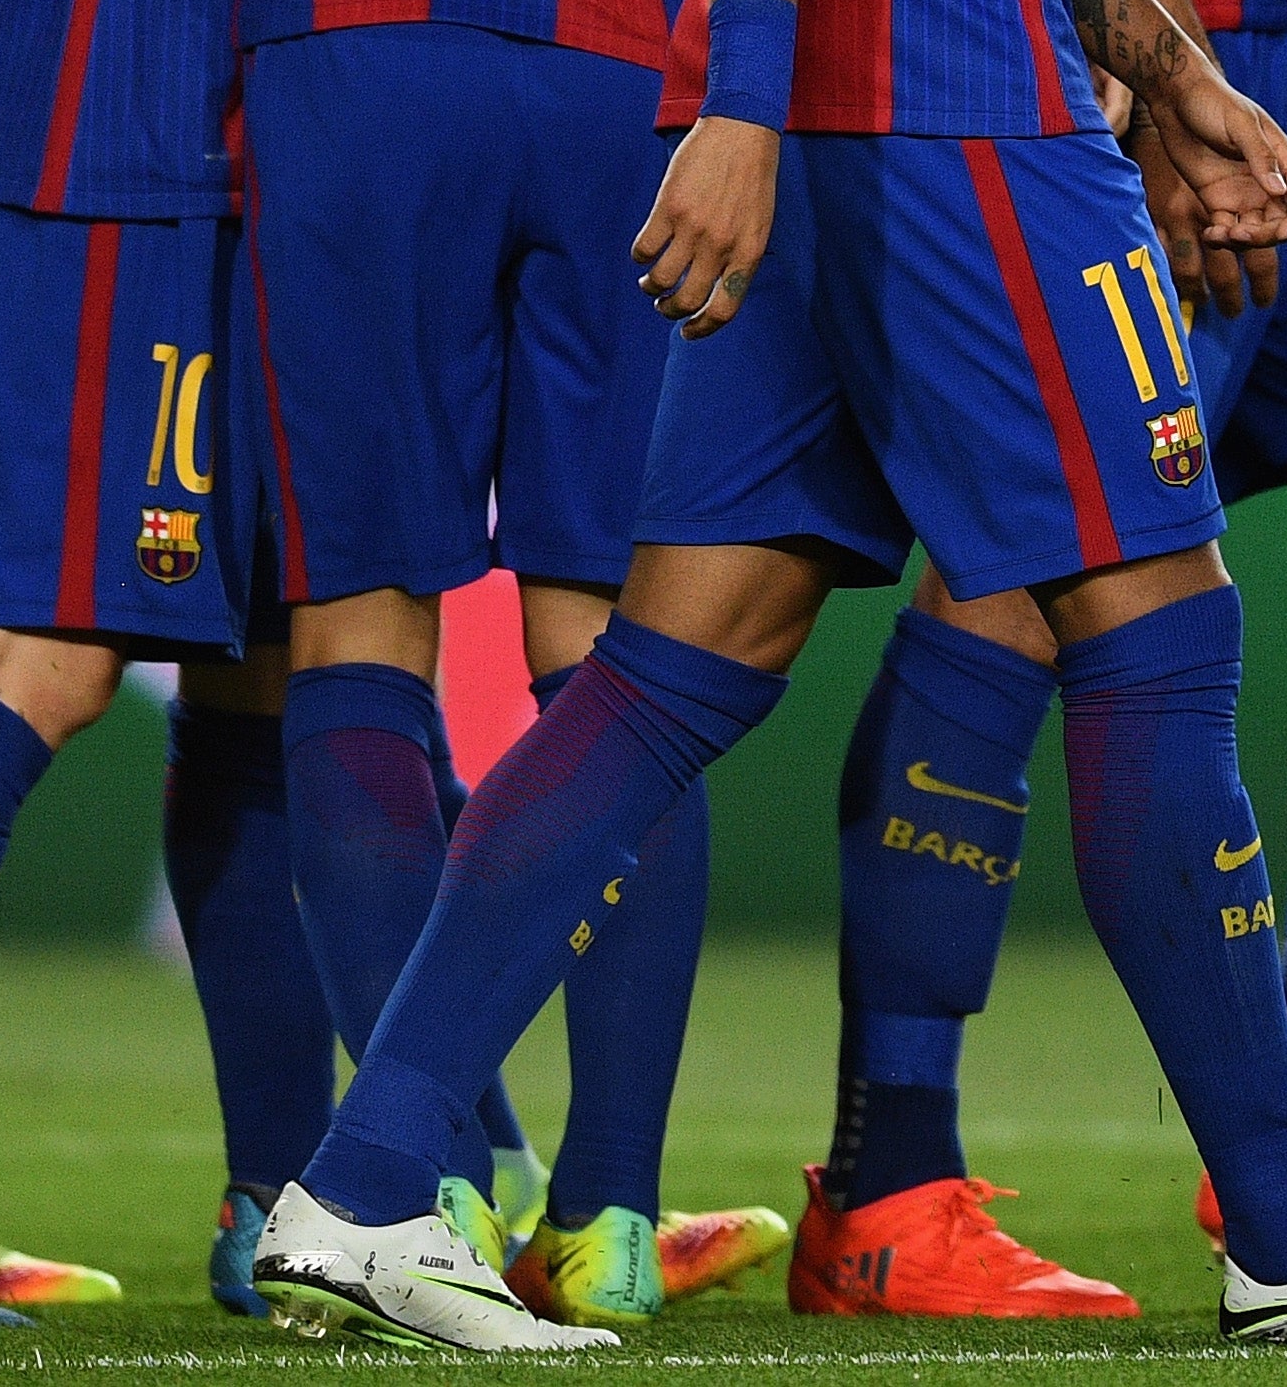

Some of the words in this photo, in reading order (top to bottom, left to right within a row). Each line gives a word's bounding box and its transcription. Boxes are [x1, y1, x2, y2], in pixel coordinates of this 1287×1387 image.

[1081, 244, 1189, 403] 11
[146, 343, 213, 494] 10
[1168, 439, 1190, 454] FCB
